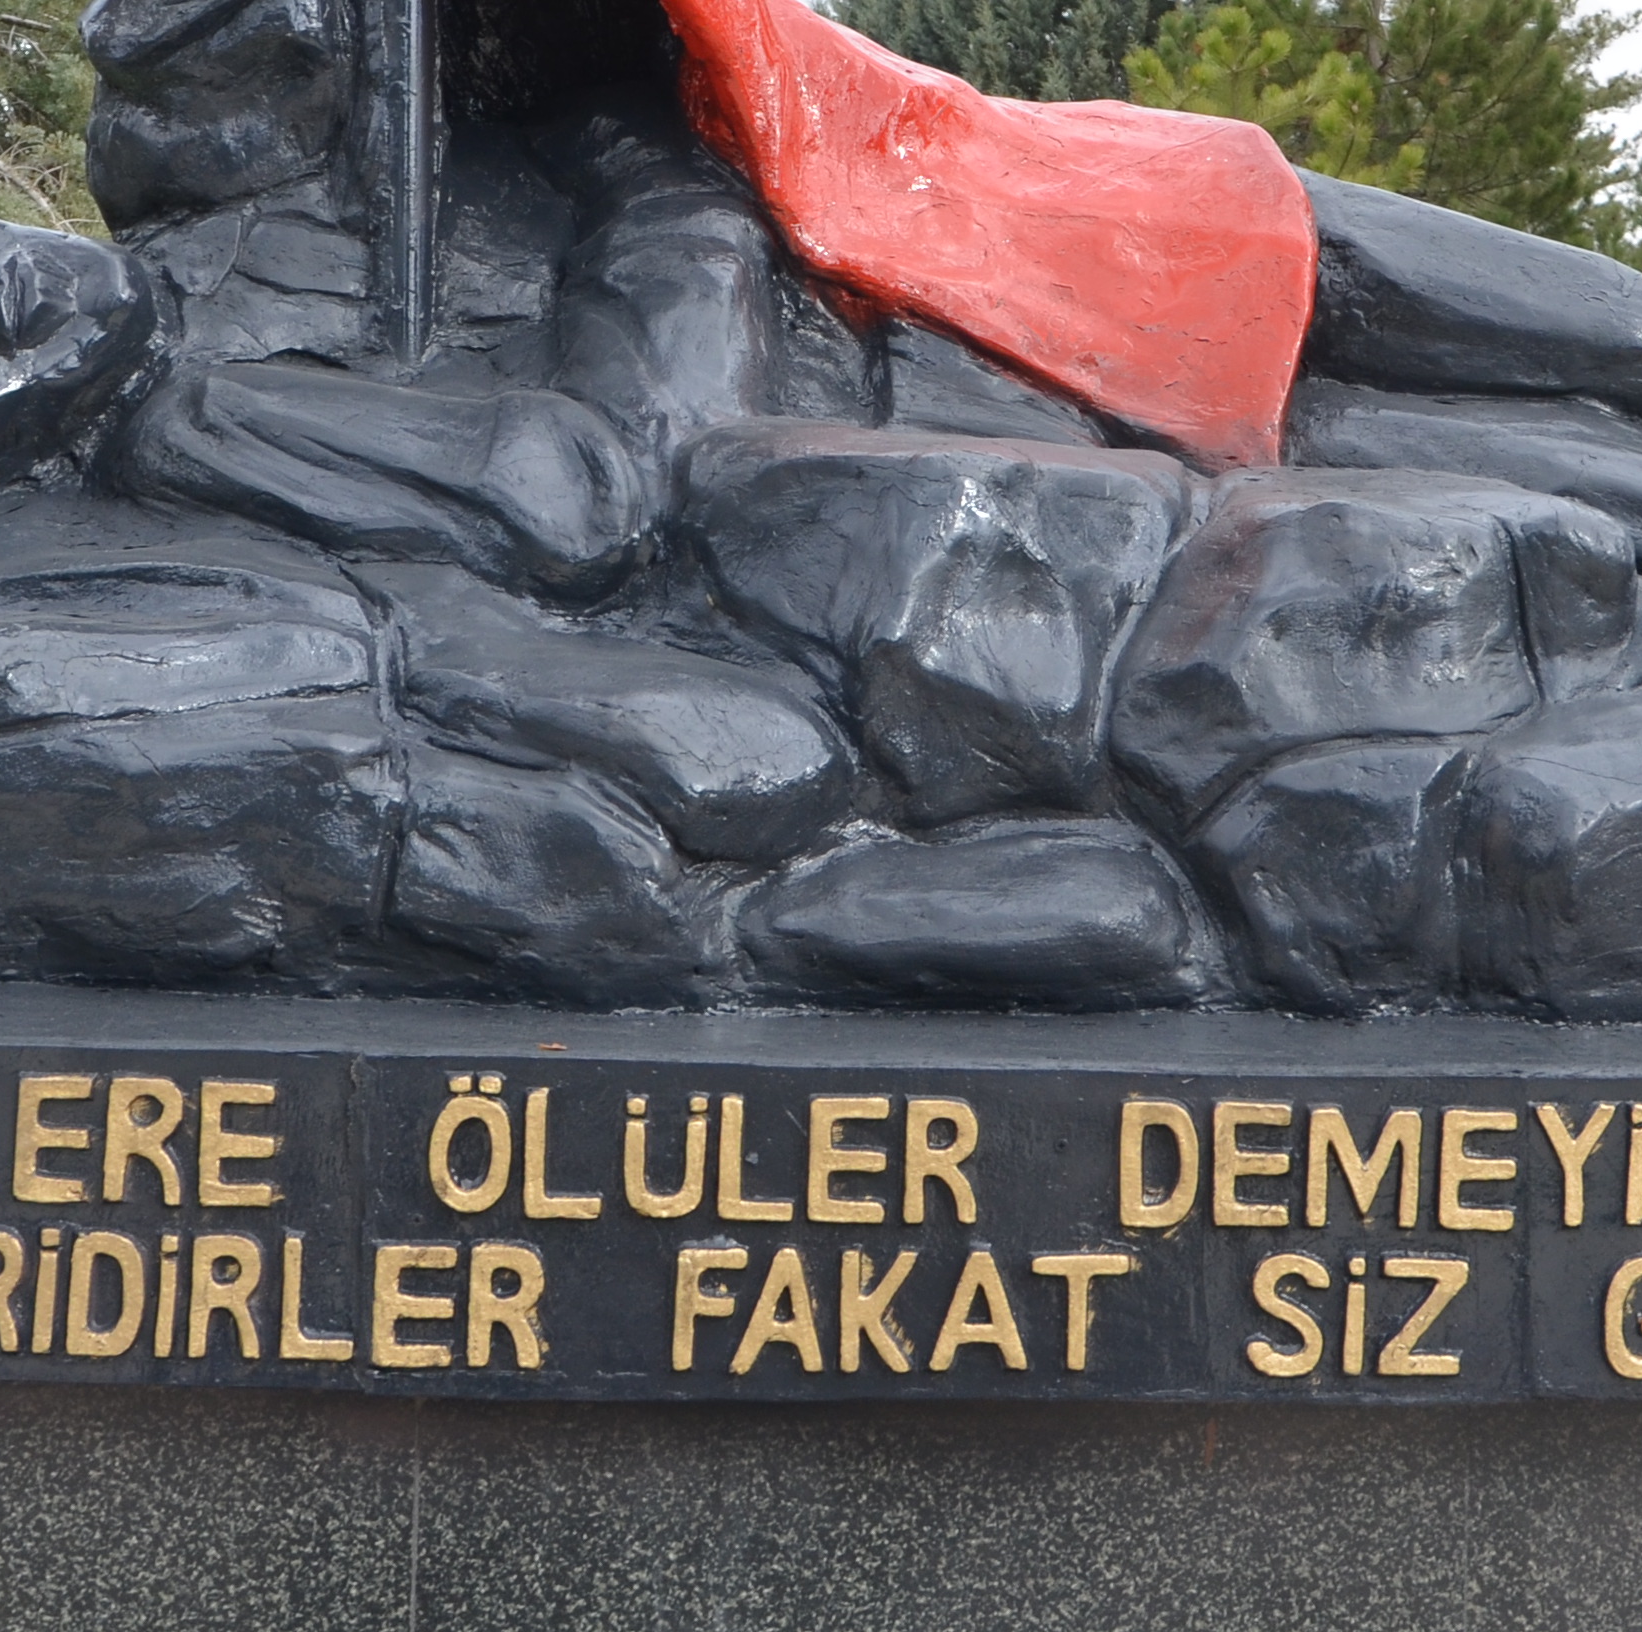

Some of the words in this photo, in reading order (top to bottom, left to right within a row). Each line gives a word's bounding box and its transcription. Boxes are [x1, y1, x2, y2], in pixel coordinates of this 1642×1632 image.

[427, 1074, 980, 1225] ÖLÜLER
[671, 1246, 1142, 1376] FAKAT
[1246, 1253, 1471, 1378] SİZ
